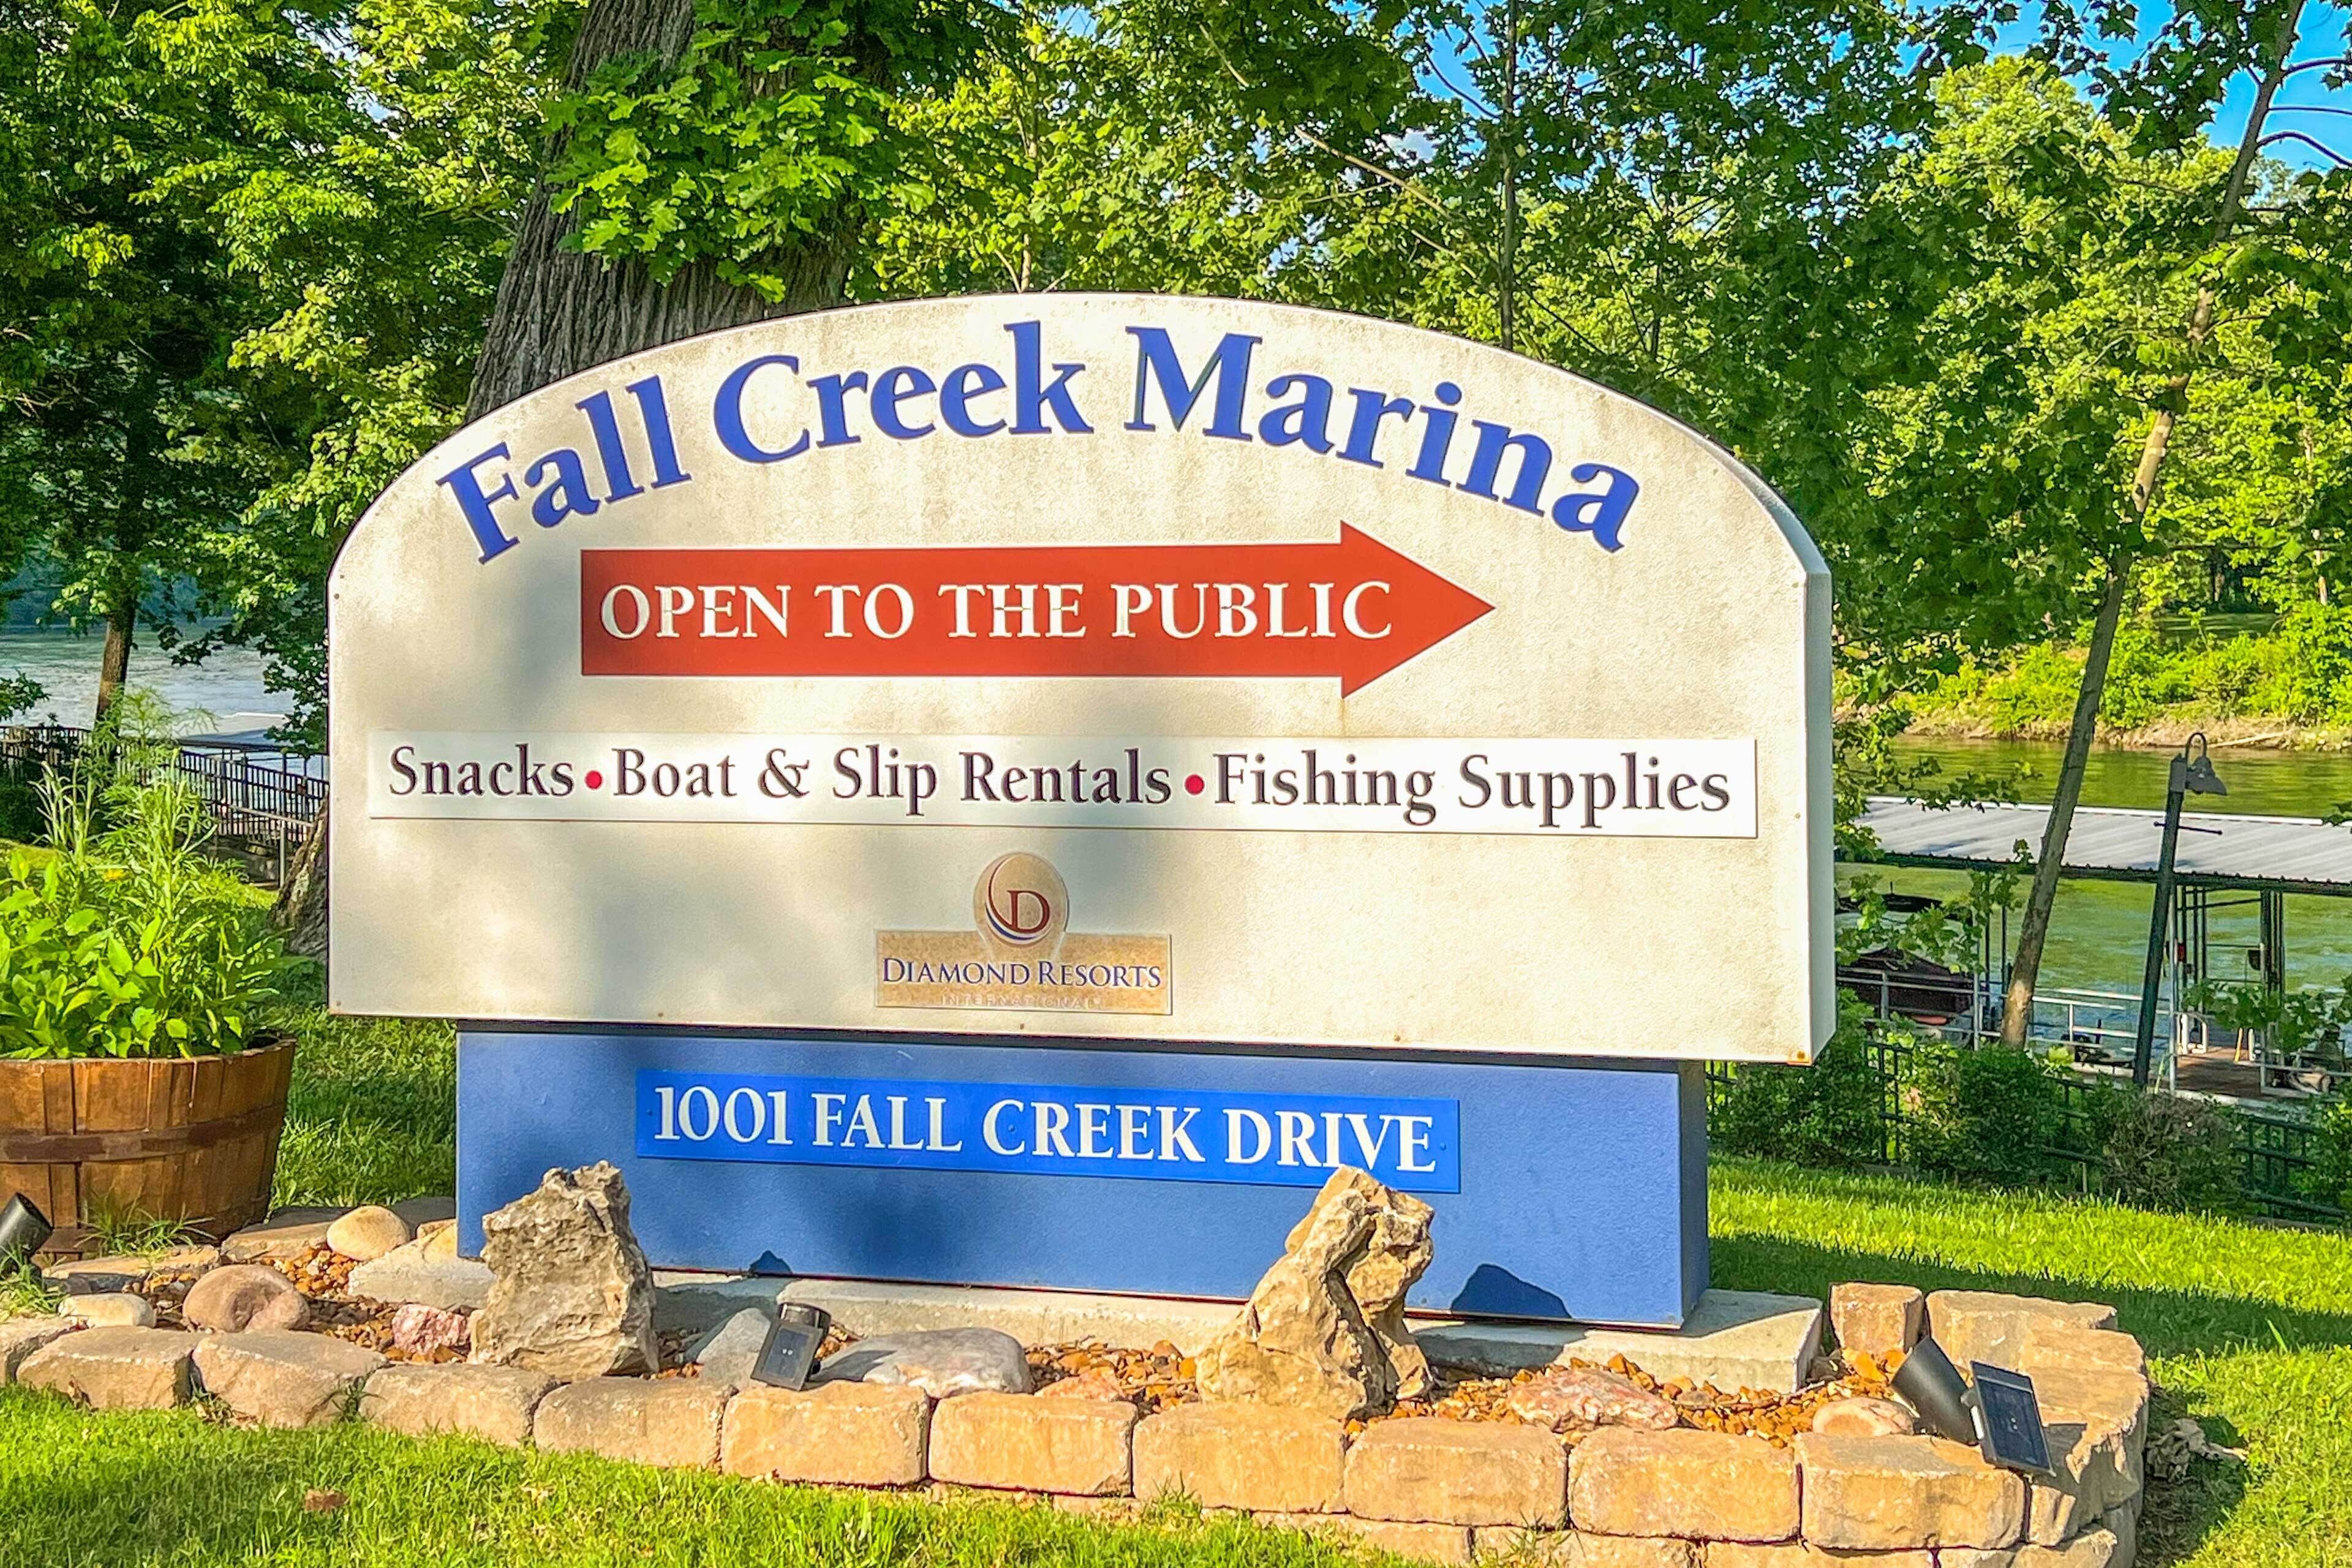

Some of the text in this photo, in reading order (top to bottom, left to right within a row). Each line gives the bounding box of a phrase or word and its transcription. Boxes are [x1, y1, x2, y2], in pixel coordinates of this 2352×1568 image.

[437, 320, 1640, 563] Fall Creek Marina
[600, 580, 1393, 639] OPEN TO THE PUBLIC
[389, 742, 1730, 829] Snacks Boat & Slip Rentals Fishing Supplies
[1006, 889, 1051, 934] D
[882, 957, 1162, 988] DIAMOND RESORTS
[654, 1085, 1438, 1172] 1001 FALL CREEK DRIVE
